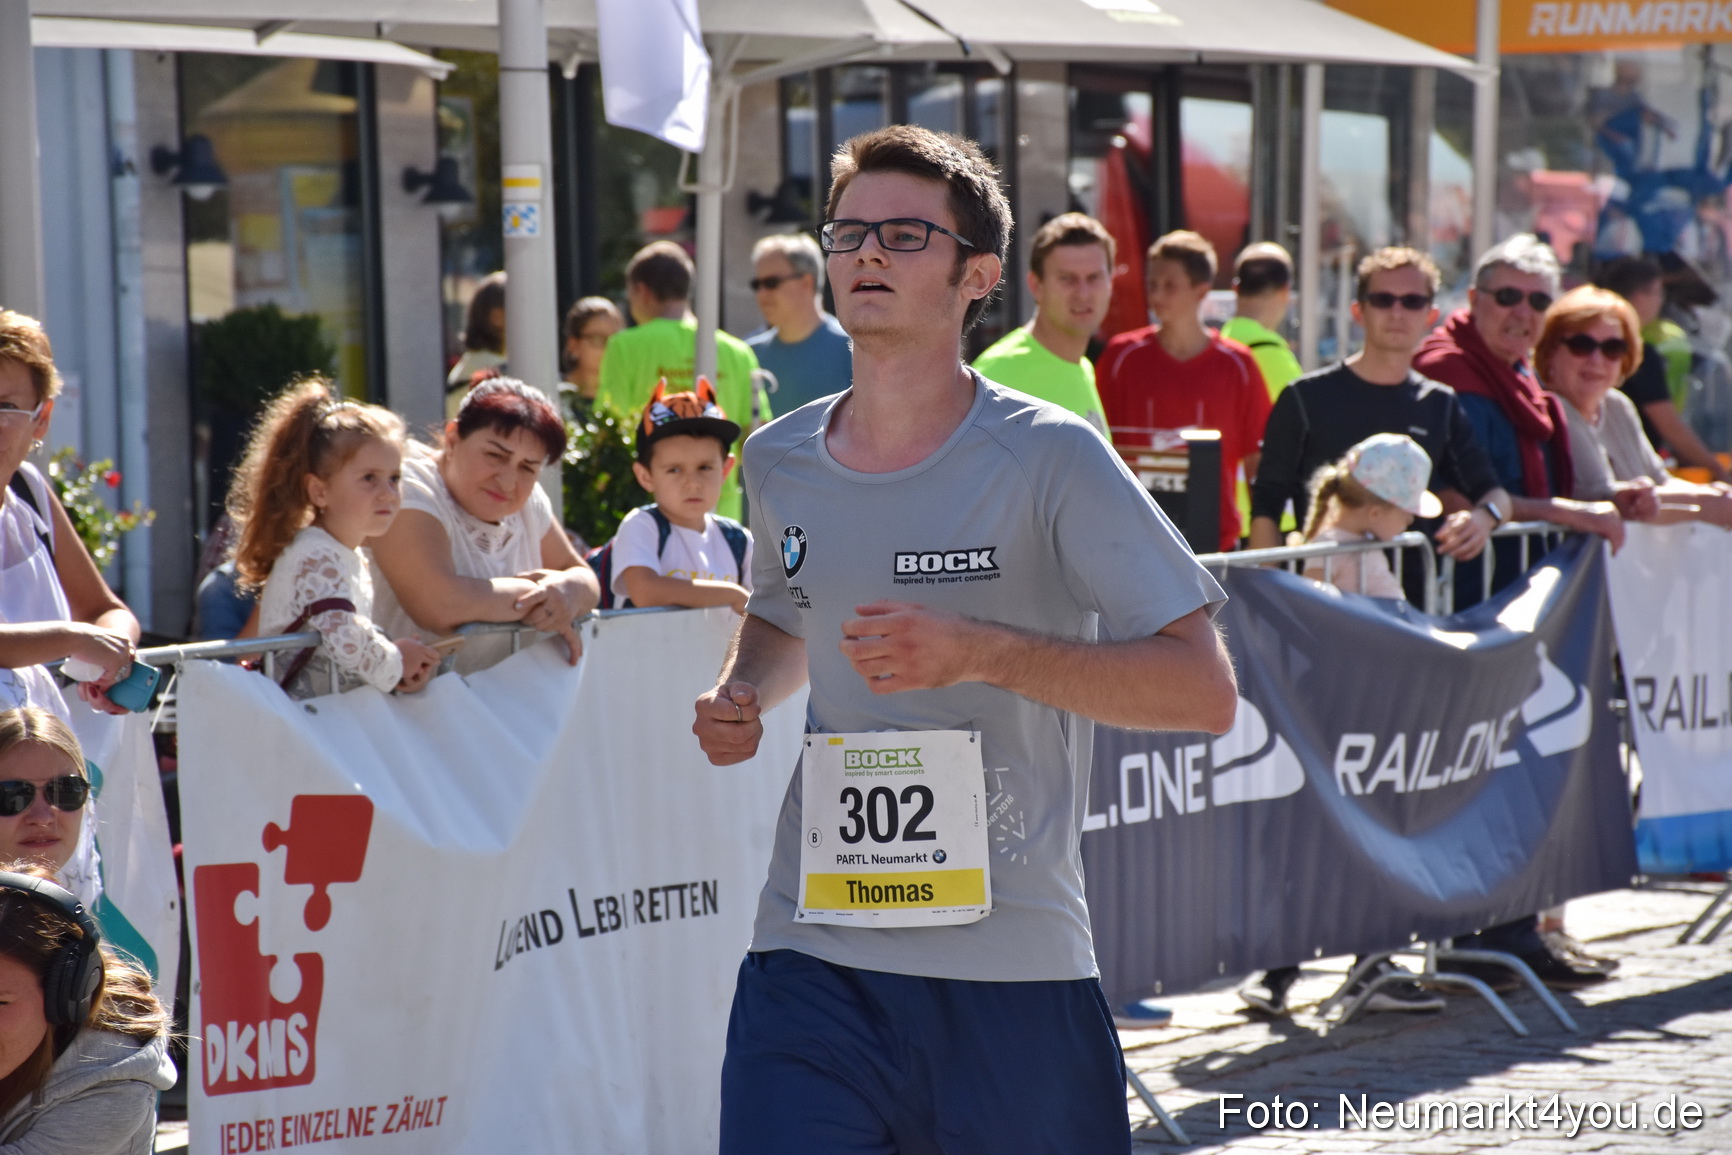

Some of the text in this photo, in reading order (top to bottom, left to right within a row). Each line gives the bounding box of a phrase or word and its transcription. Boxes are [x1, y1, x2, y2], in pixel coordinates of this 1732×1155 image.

[893, 577, 923, 585] inspired
[926, 577, 935, 585] by
[965, 572, 1000, 581] concepts
[895, 548, 998, 575] BOCK
[1633, 672, 1732, 731] RAIL.
[845, 748, 922, 768] BOCK
[1334, 707, 1520, 796] RAIL.ONE
[839, 785, 936, 844] 302
[996, 794, 1014, 815] 2018
[836, 855, 869, 865] PARTL
[871, 853, 928, 864] Neumarkt
[633, 879, 718, 926] RETTEN
[846, 880, 934, 903] Thomas
[205, 1012, 309, 1087] DKMS
[281, 1106, 377, 1148] EINZELNE
[382, 1096, 448, 1134] ZÄHLT
